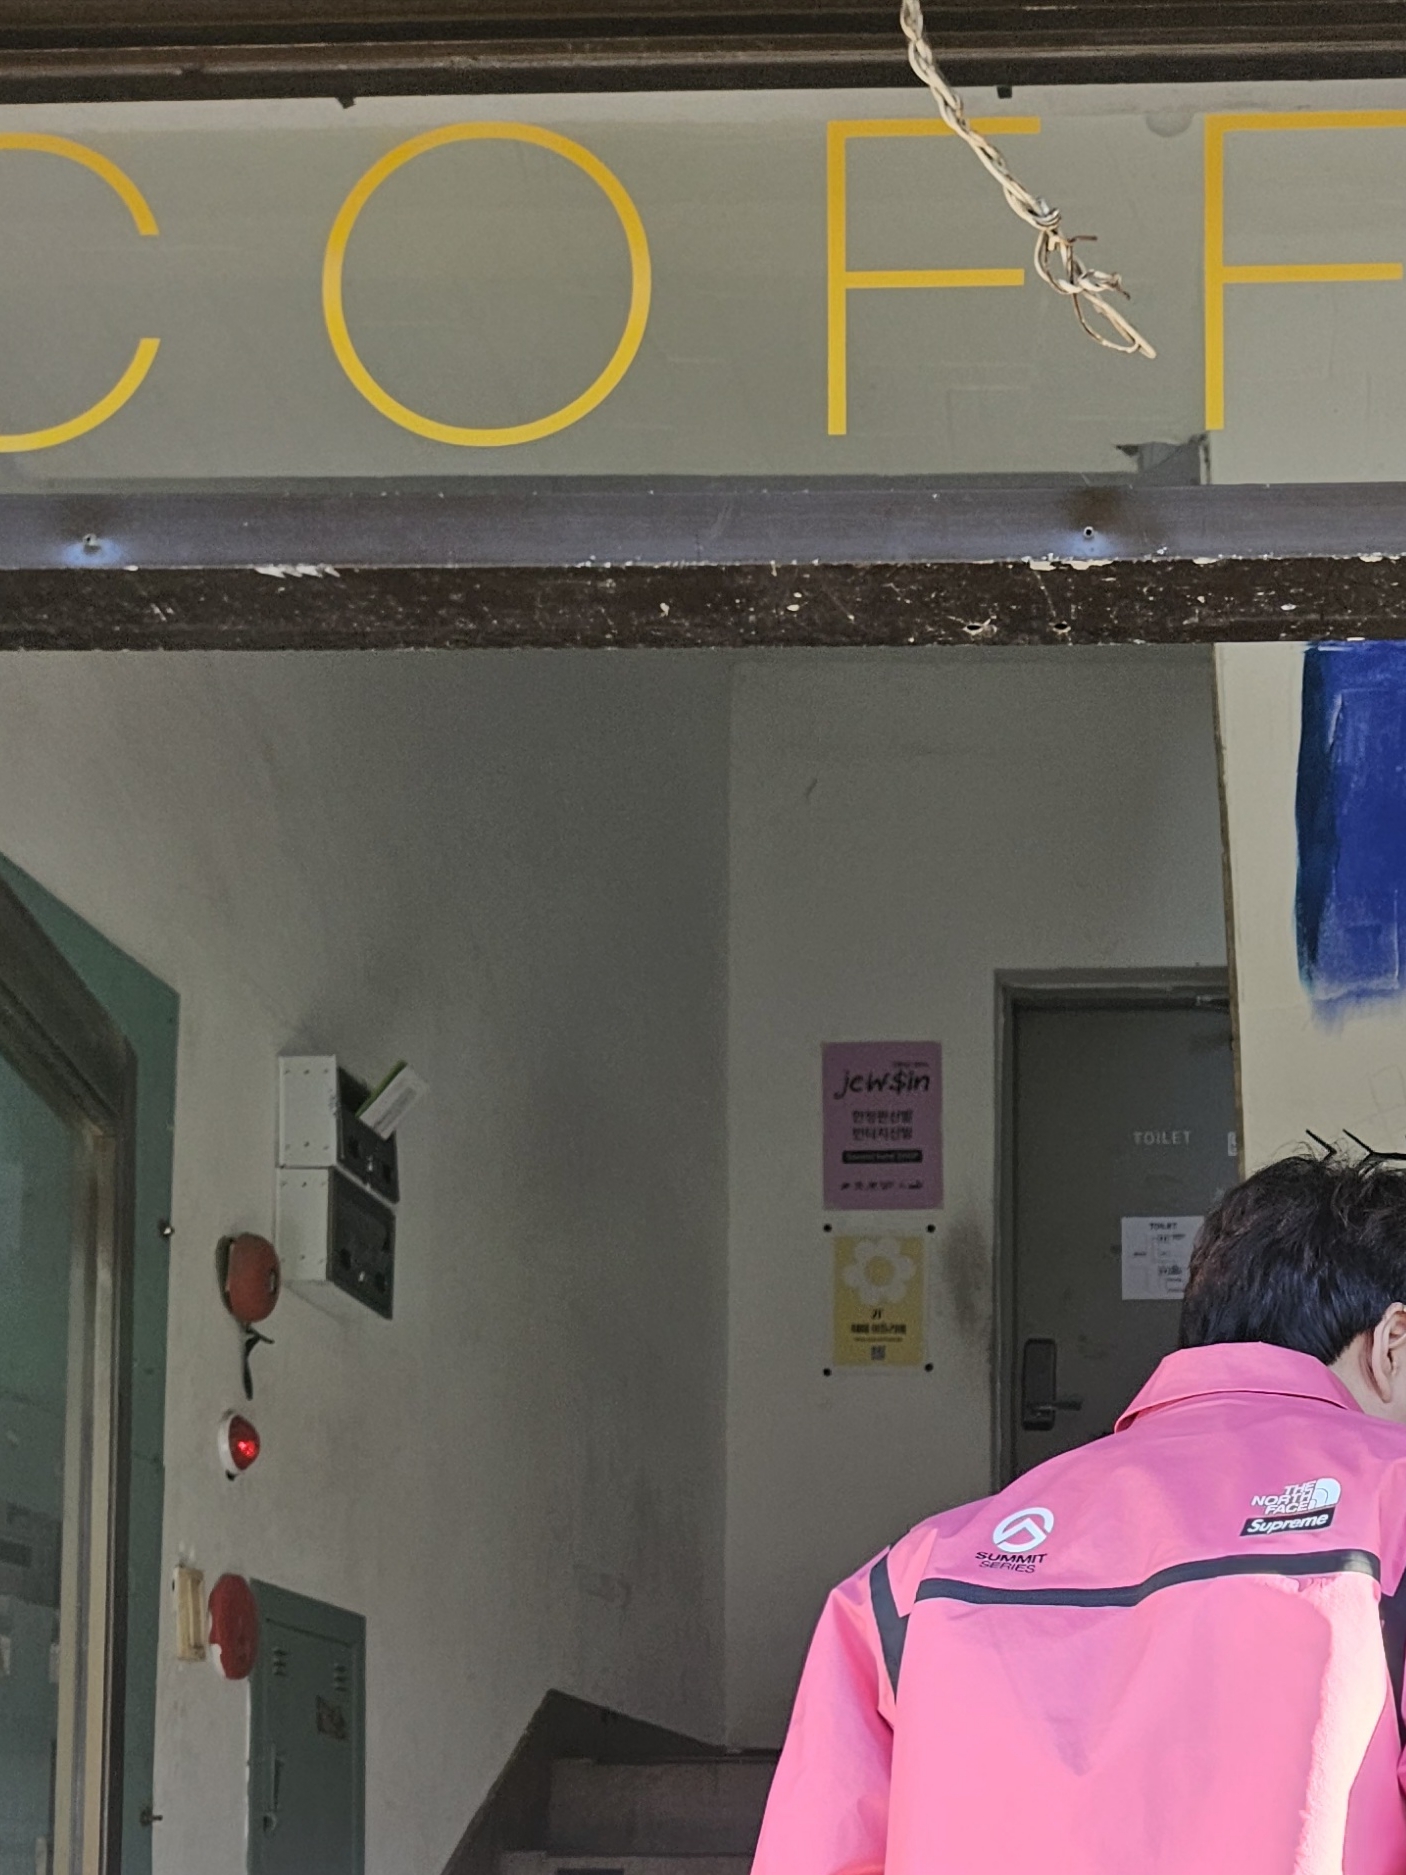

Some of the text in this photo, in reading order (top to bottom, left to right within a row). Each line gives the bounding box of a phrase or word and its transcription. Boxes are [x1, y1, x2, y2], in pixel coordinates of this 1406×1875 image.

[1133, 1131, 1192, 1146] TOILET
[1284, 1480, 1316, 1496] THE
[1251, 1488, 1314, 1506] NORTH
[1264, 1501, 1308, 1515] FACE
[1246, 1514, 1329, 1534] Supreme
[975, 1551, 1048, 1564] SUMMIT
[979, 1560, 1036, 1574] SERIES
